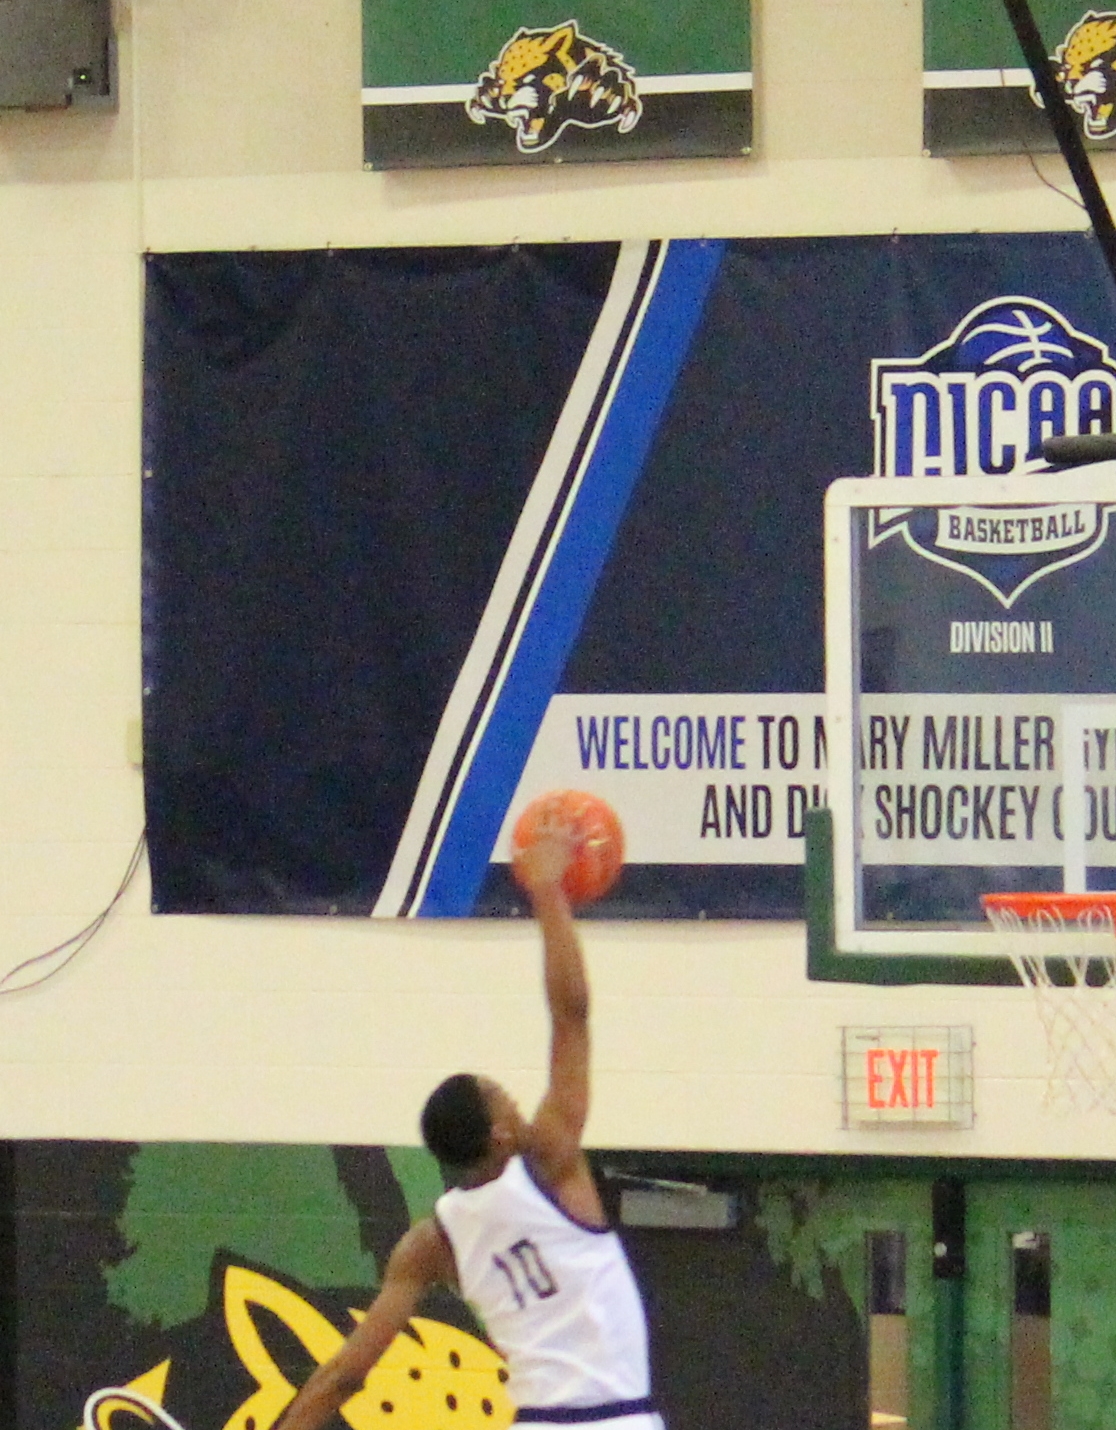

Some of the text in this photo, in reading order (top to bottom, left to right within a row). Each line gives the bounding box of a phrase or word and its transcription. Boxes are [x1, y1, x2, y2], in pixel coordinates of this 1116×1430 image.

[947, 509, 1086, 545] BASKETBALL
[949, 621, 1054, 653] DIVISION II
[576, 714, 746, 771] WELCOME
[757, 714, 800, 771] TO
[814, 714, 911, 771] MRY
[923, 714, 1055, 772] MILLER
[700, 783, 772, 840] AND
[875, 783, 1041, 841] SHOCKEY
[865, 1048, 940, 1109] EXIT
[491, 1238, 560, 1310] 10
